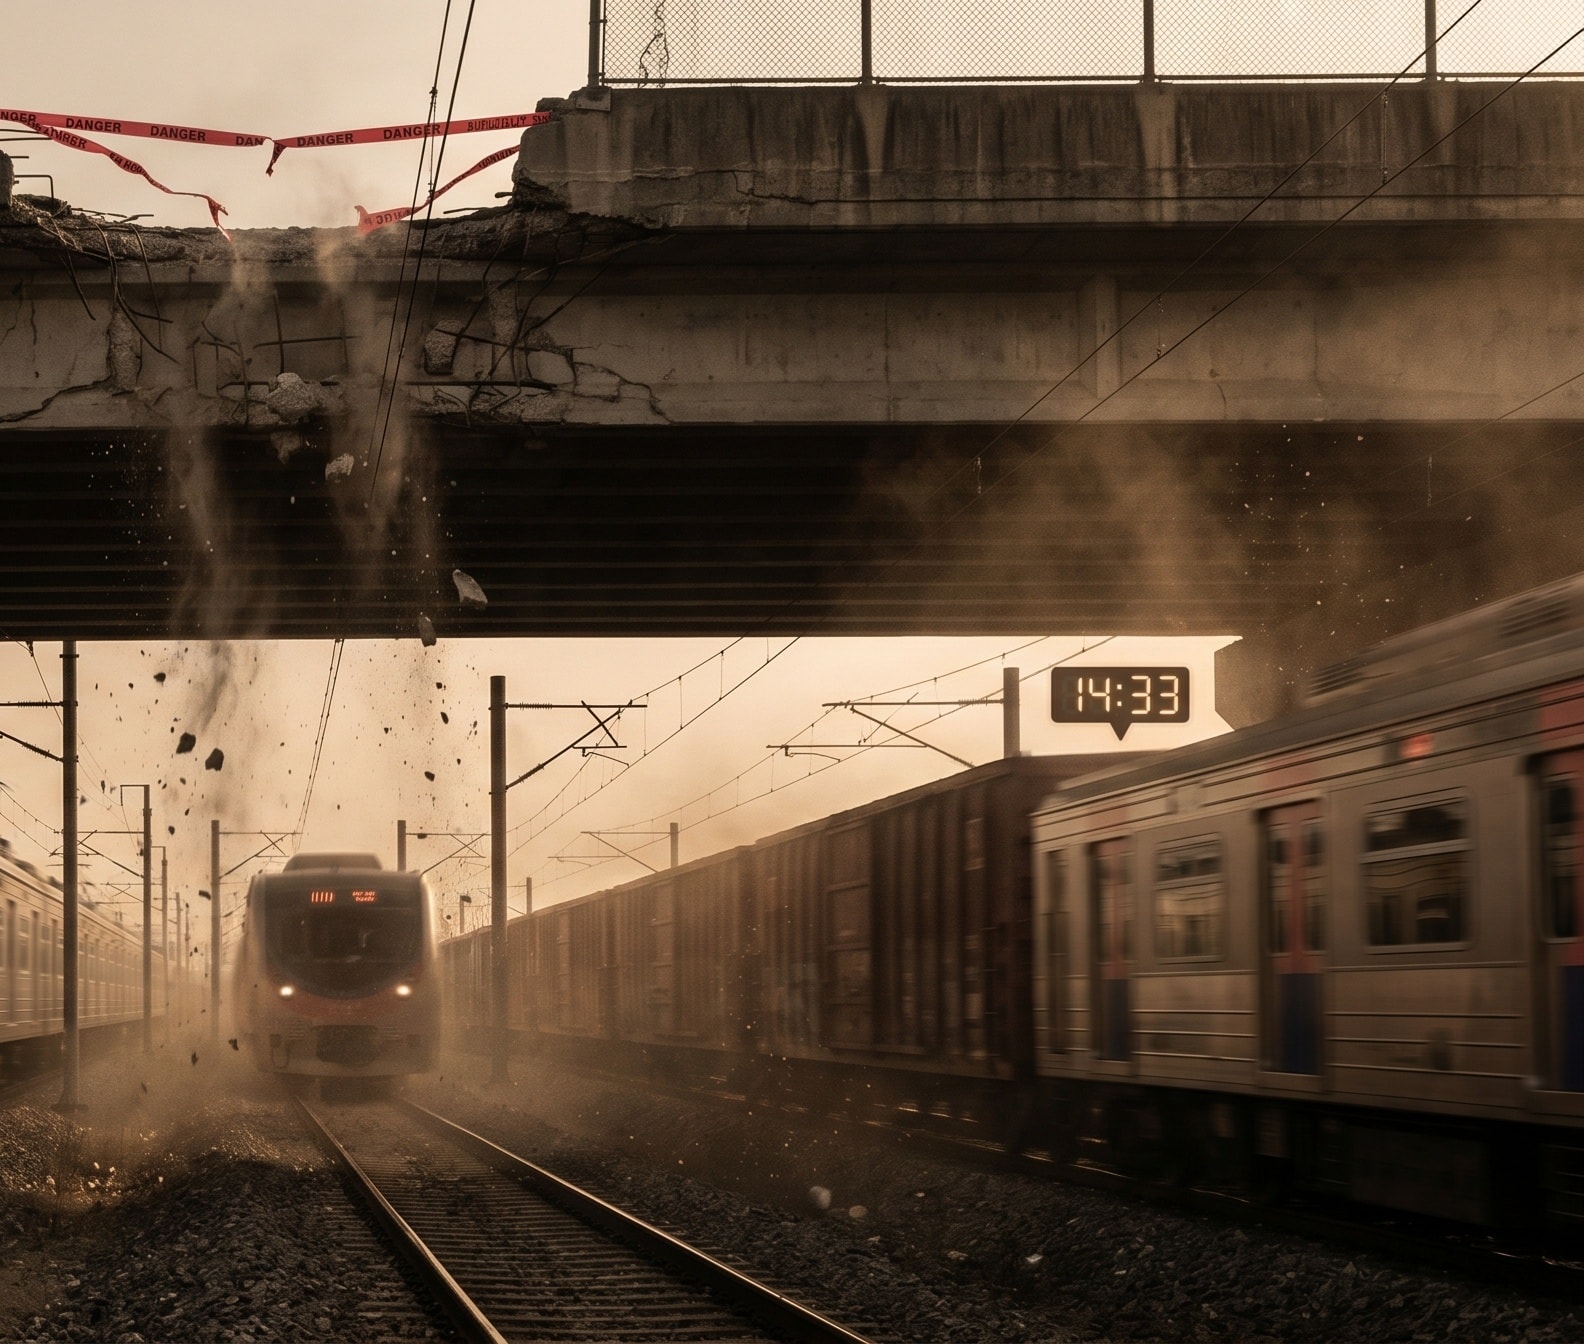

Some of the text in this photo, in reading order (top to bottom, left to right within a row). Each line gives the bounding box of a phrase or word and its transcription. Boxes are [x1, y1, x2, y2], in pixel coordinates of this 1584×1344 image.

[66, 118, 121, 132] DANGER
[150, 125, 206, 141] DANGER
[297, 124, 441, 147] DANGER DANGER
